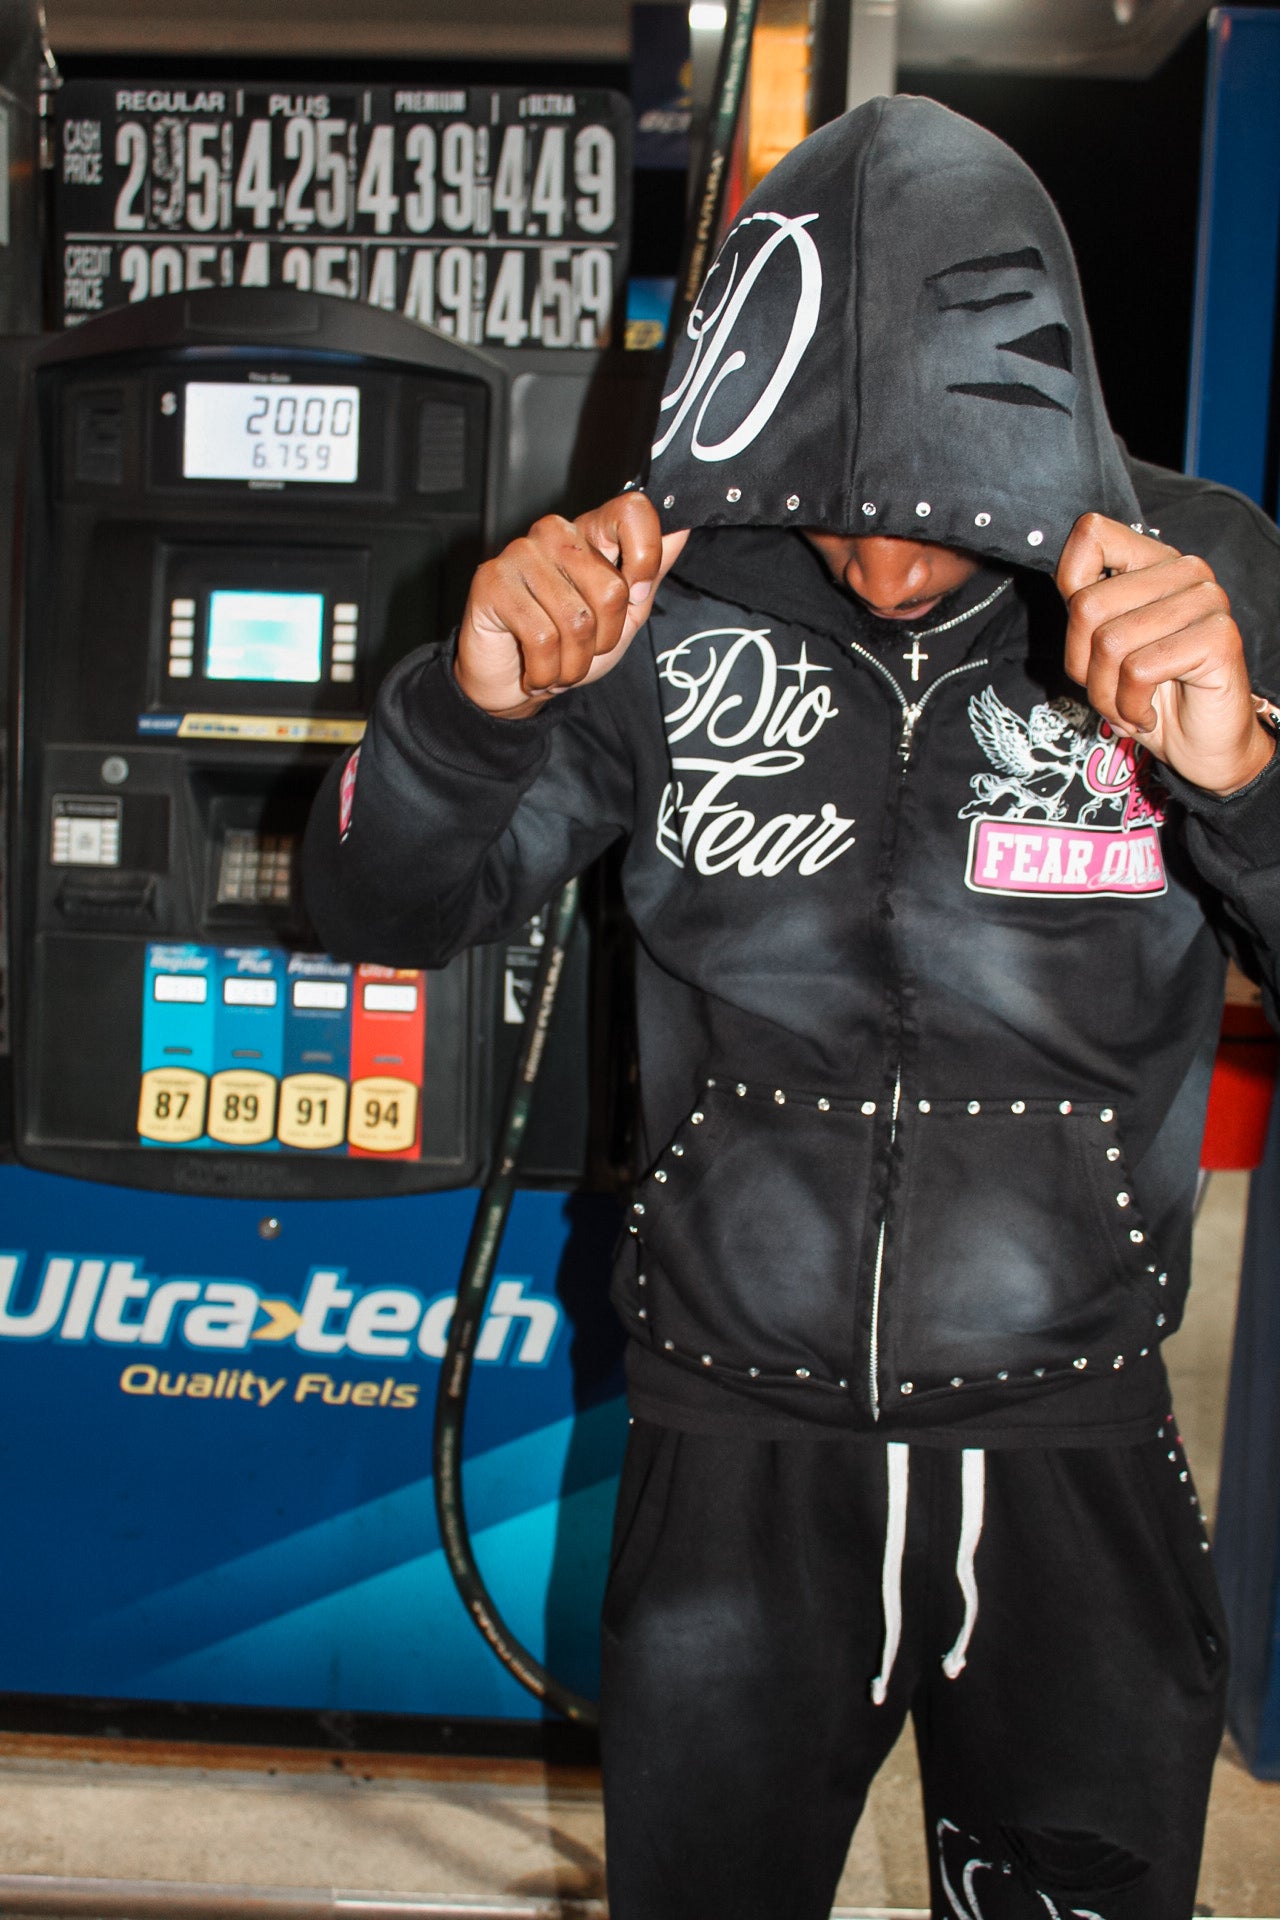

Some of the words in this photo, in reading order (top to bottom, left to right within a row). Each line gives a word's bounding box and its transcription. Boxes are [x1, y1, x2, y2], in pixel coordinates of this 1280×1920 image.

[115, 90, 226, 113] REGULAR
[268, 94, 330, 118] PLUS
[394, 91, 467, 113] PREMIUM
[64, 119, 101, 151] CASH
[64, 153, 103, 184] PRICE
[64, 278, 103, 309] PRICE
[656, 750, 856, 878] Fear
[981, 831, 1094, 885] FEAR
[1100, 836, 1164, 885] ONE
[154, 1091, 191, 1120] 87
[223, 1094, 260, 1123] 89
[295, 1097, 330, 1127] 91
[364, 1099, 400, 1130] 94
[119, 1363, 286, 1407] Quality
[295, 1372, 419, 1409] Fuels
